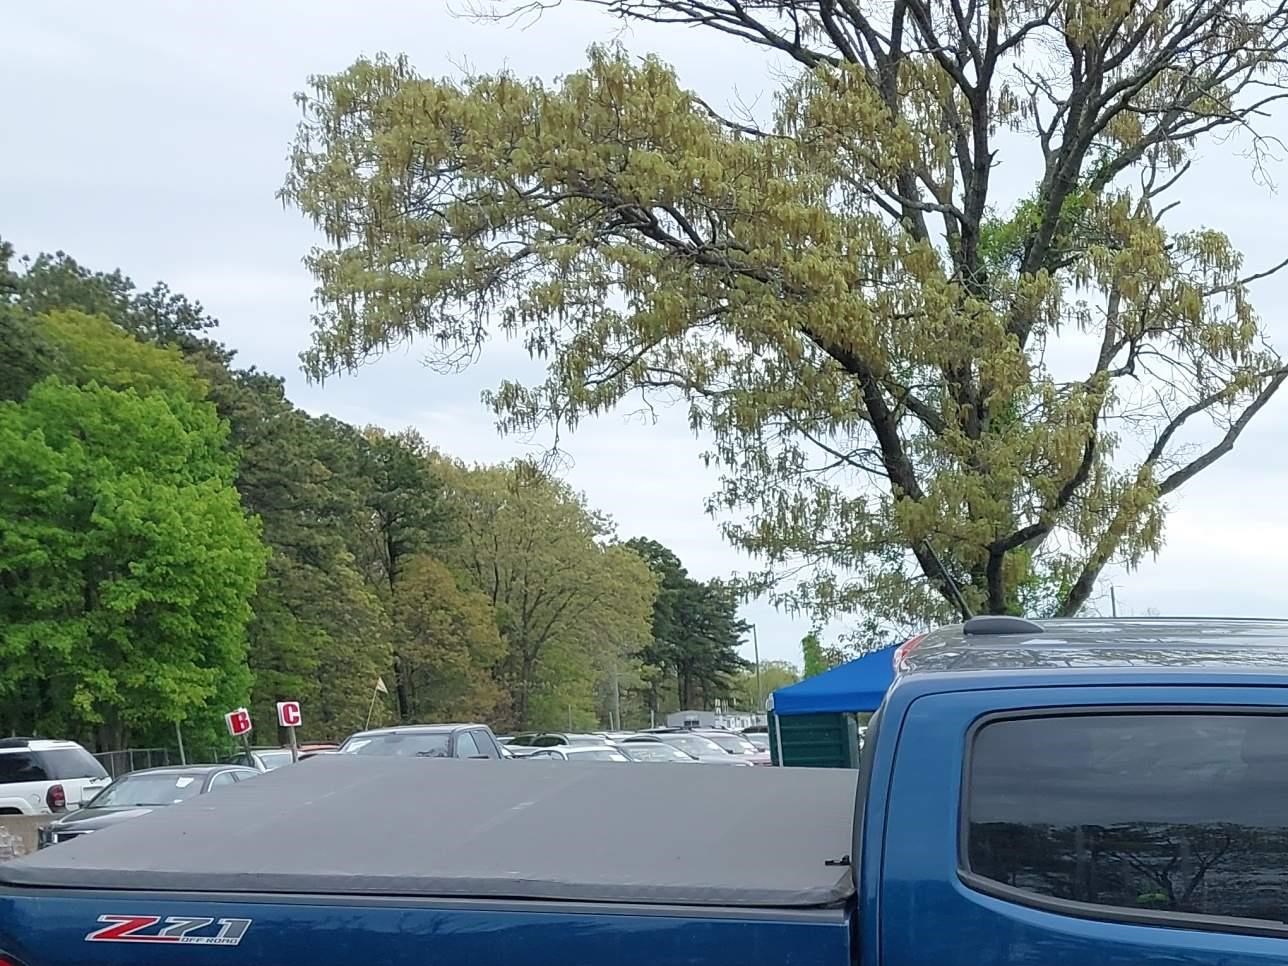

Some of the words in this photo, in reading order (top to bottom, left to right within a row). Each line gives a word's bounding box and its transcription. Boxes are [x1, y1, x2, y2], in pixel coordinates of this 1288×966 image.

[230, 711, 250, 734] B
[282, 703, 300, 725] C
[85, 914, 252, 944] Z71
